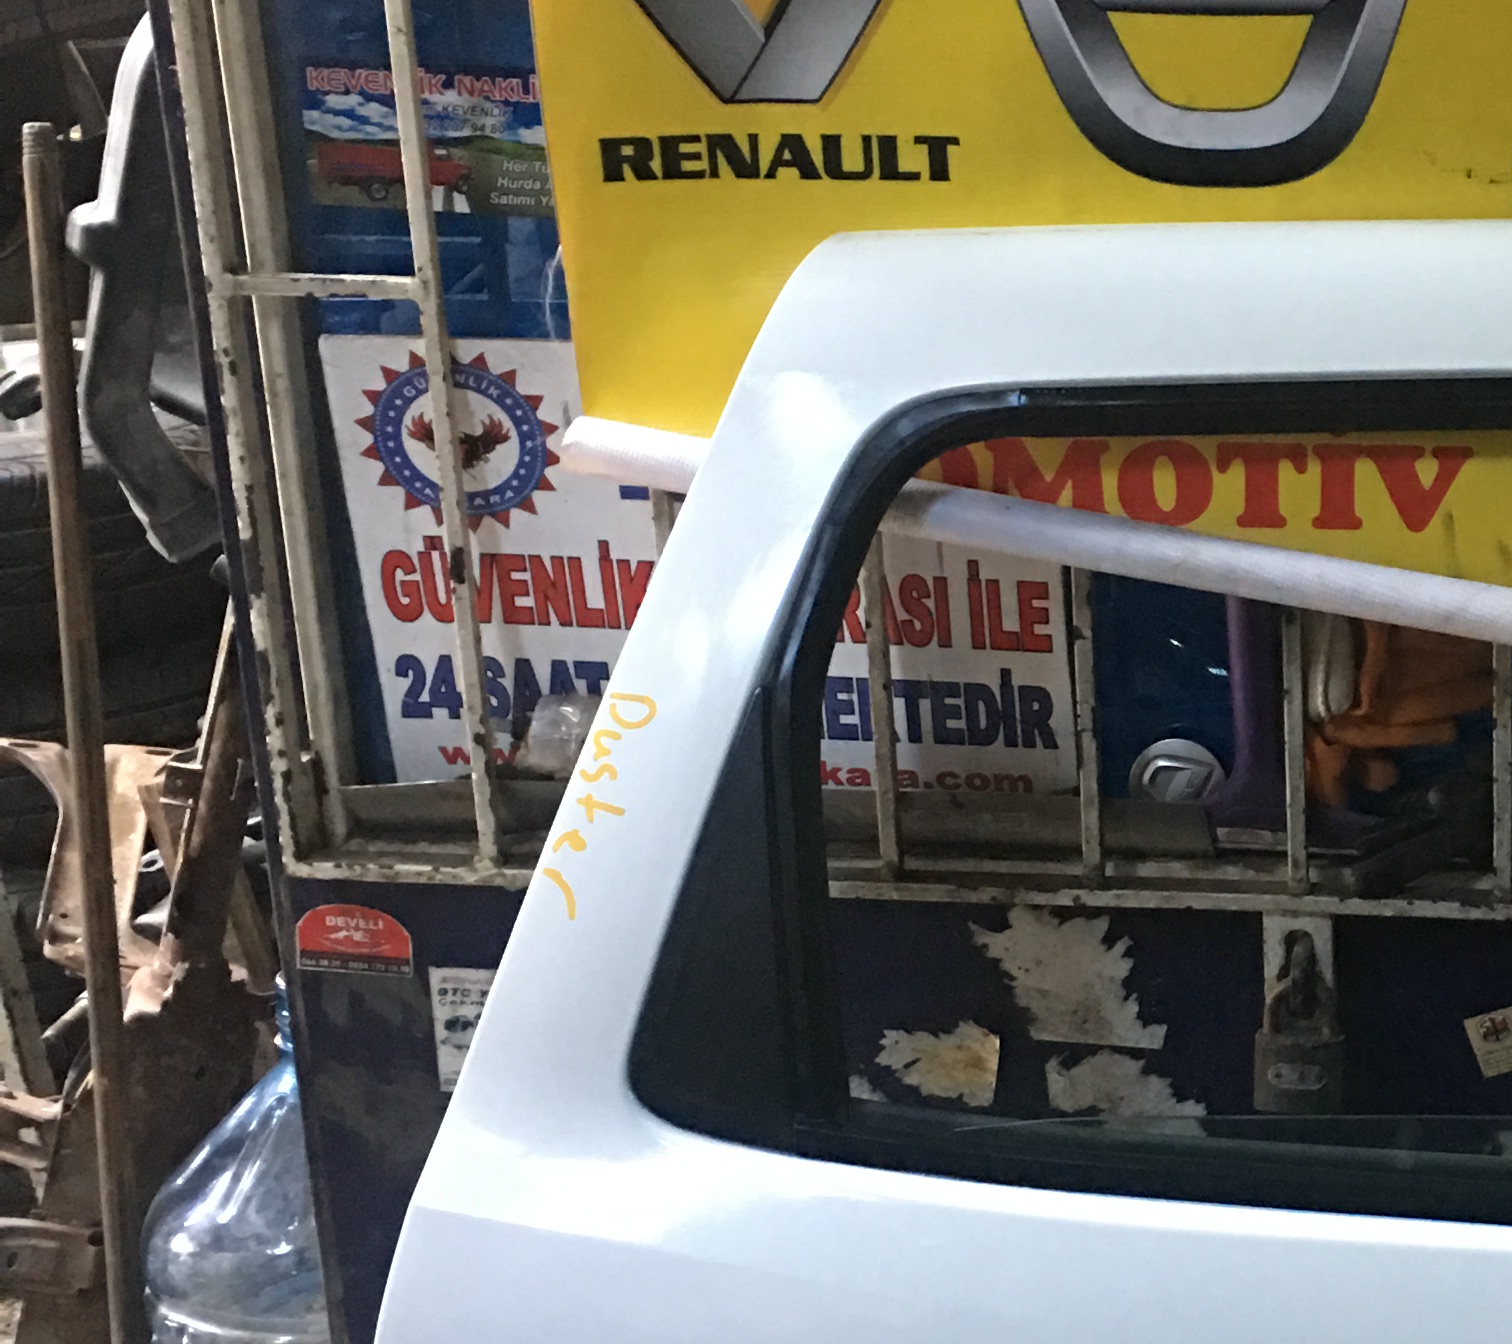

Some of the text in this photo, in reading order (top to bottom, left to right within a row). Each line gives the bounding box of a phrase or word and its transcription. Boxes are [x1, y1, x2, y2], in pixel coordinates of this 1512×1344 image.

[502, 159, 528, 173] Her
[598, 133, 960, 183] RENAULT
[497, 175, 541, 190] Hurda
[967, 559, 1054, 653] İLE
[395, 654, 464, 720] 24
[820, 760, 1033, 794] kaa.com
